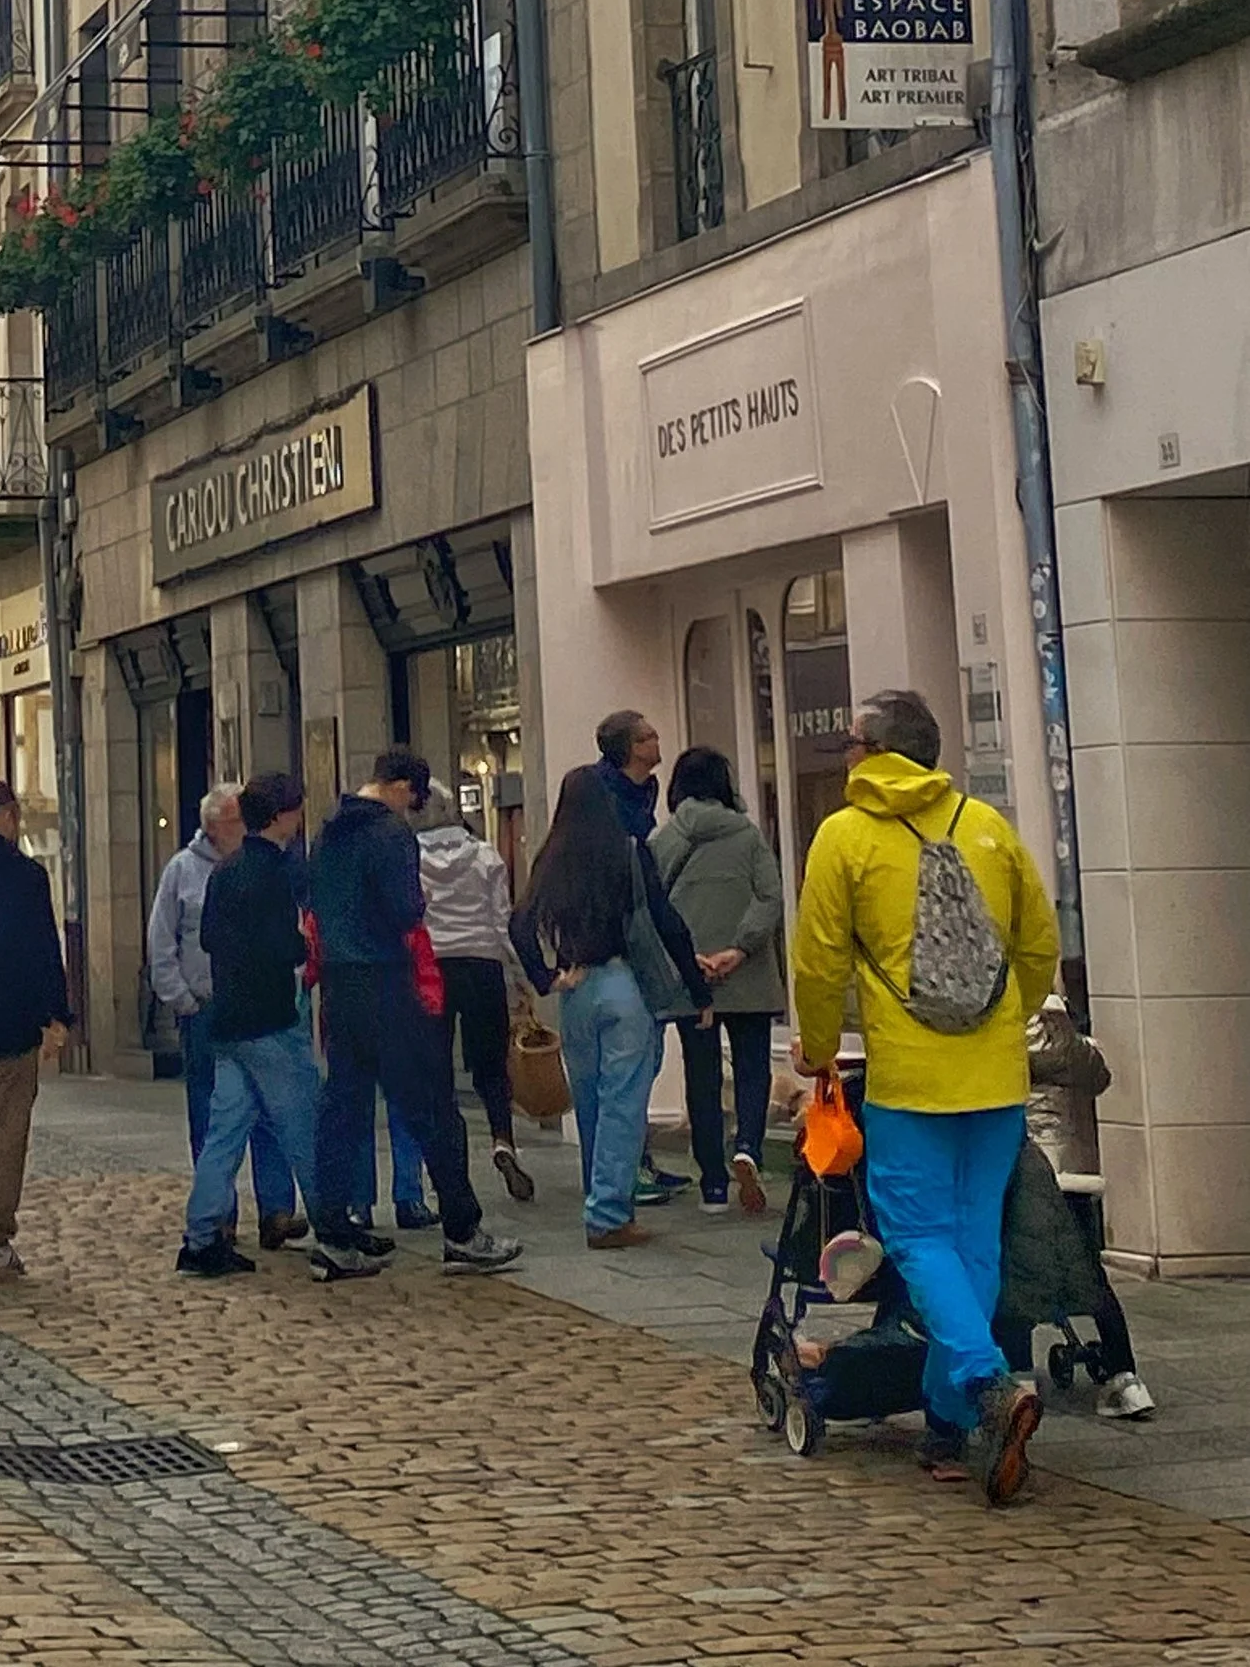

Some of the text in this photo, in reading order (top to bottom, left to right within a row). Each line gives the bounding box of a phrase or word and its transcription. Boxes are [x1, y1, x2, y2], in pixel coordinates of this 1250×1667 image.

[855, 19, 965, 39] BAOBAB
[865, 68, 958, 84] ART TRIBAL
[860, 89, 965, 105] ART PREMIER
[657, 378, 799, 459] DES PETITS HAUTS
[165, 472, 233, 552] CARIOU
